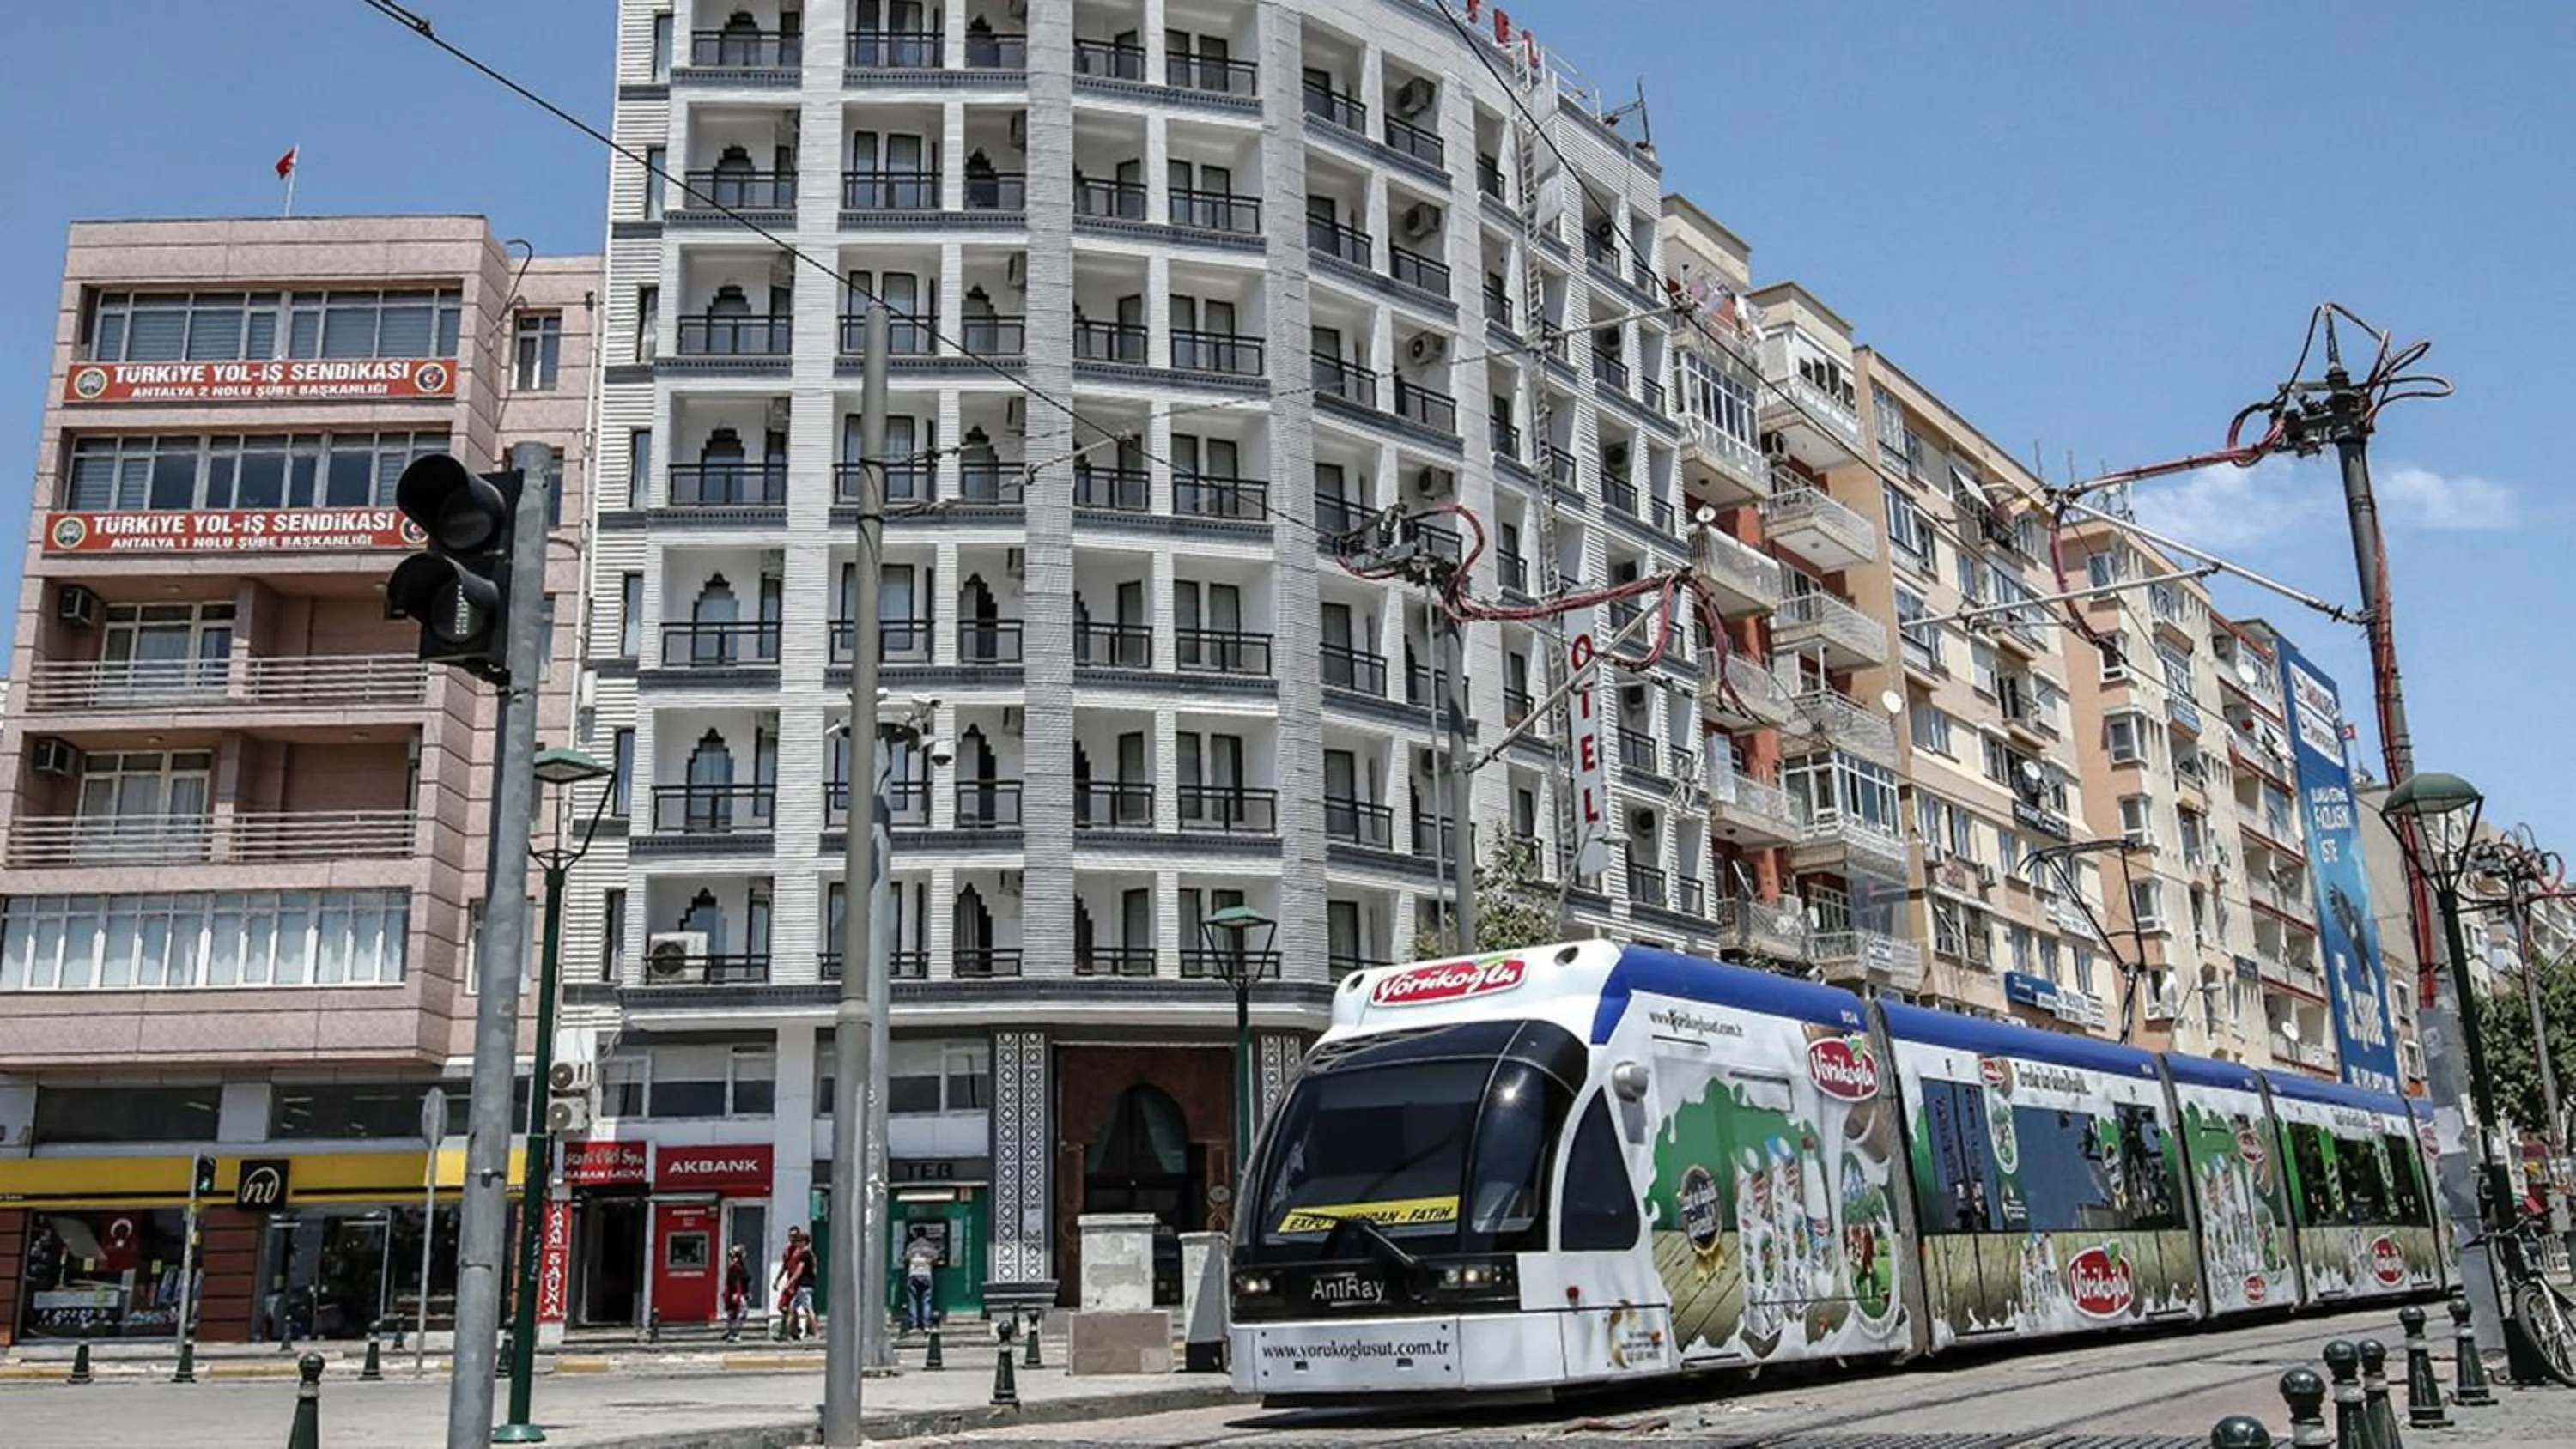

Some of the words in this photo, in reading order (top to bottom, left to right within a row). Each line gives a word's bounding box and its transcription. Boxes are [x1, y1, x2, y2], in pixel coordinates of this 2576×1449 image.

[131, 385, 194, 398] ANTALYA
[198, 385, 208, 397] 2
[212, 385, 251, 397] NOLU
[111, 537, 174, 549] ANTALYA
[193, 537, 233, 548] NOLU
[1571, 633, 1600, 825] OTEL
[668, 1160, 760, 1174] AKBANK
[906, 1161, 955, 1179] TEB
[542, 1252, 562, 1317] SAUNA
